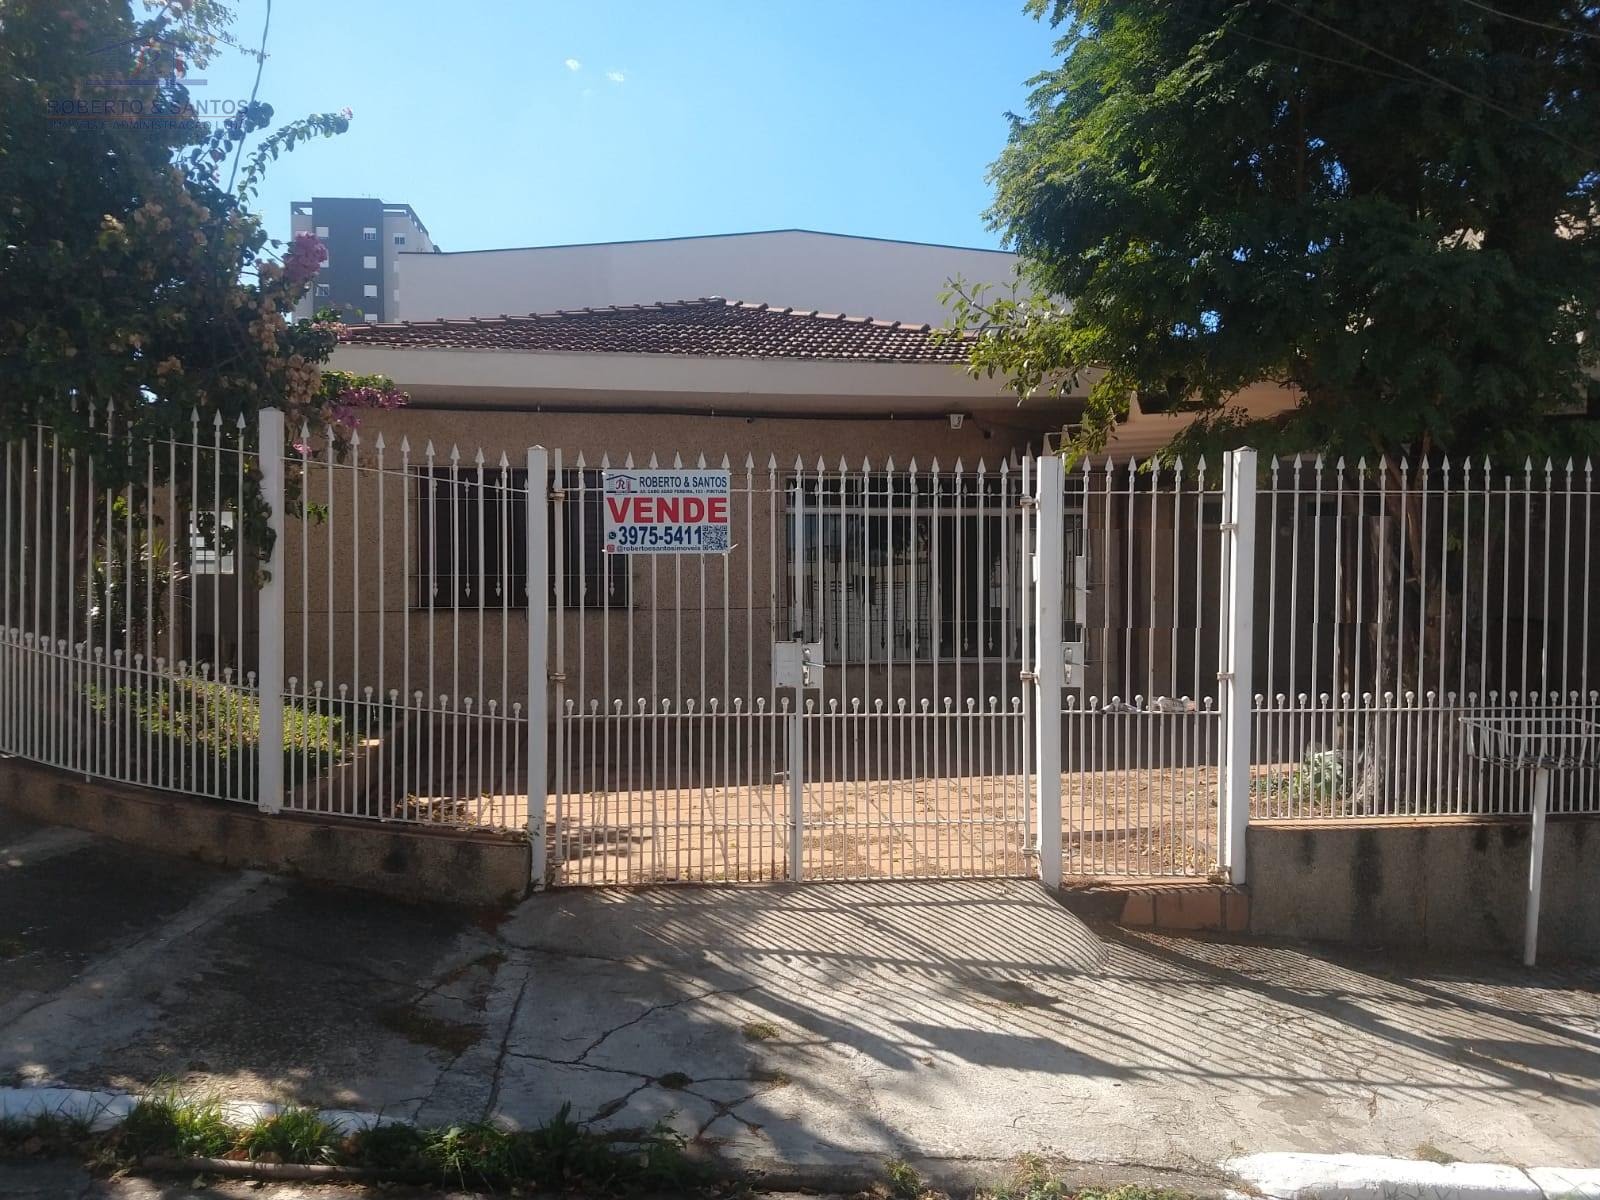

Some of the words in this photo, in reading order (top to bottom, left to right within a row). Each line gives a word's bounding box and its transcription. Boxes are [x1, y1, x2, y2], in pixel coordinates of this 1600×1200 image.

[639, 476, 682, 488] ROBERTO
[684, 476, 690, 488] &
[692, 476, 727, 488] SANTOS
[607, 497, 728, 523] VENDE
[618, 526, 702, 545] 3975-5411
